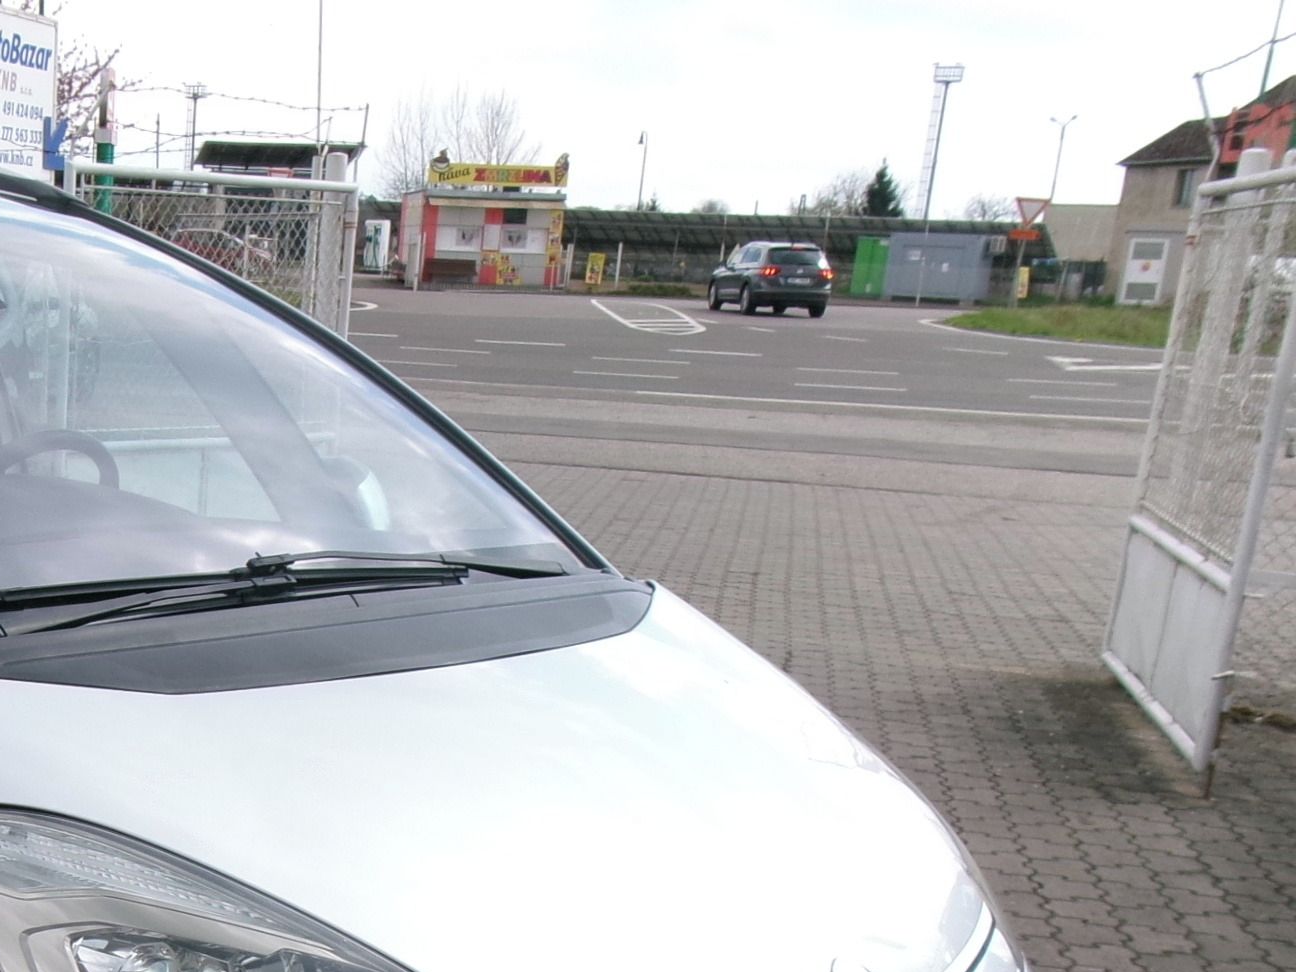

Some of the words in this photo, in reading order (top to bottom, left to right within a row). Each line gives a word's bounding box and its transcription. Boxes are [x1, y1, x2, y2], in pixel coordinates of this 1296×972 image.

[2, 100, 15, 116] 491
[15, 103, 29, 119] 424
[1, 126, 14, 141] 777
